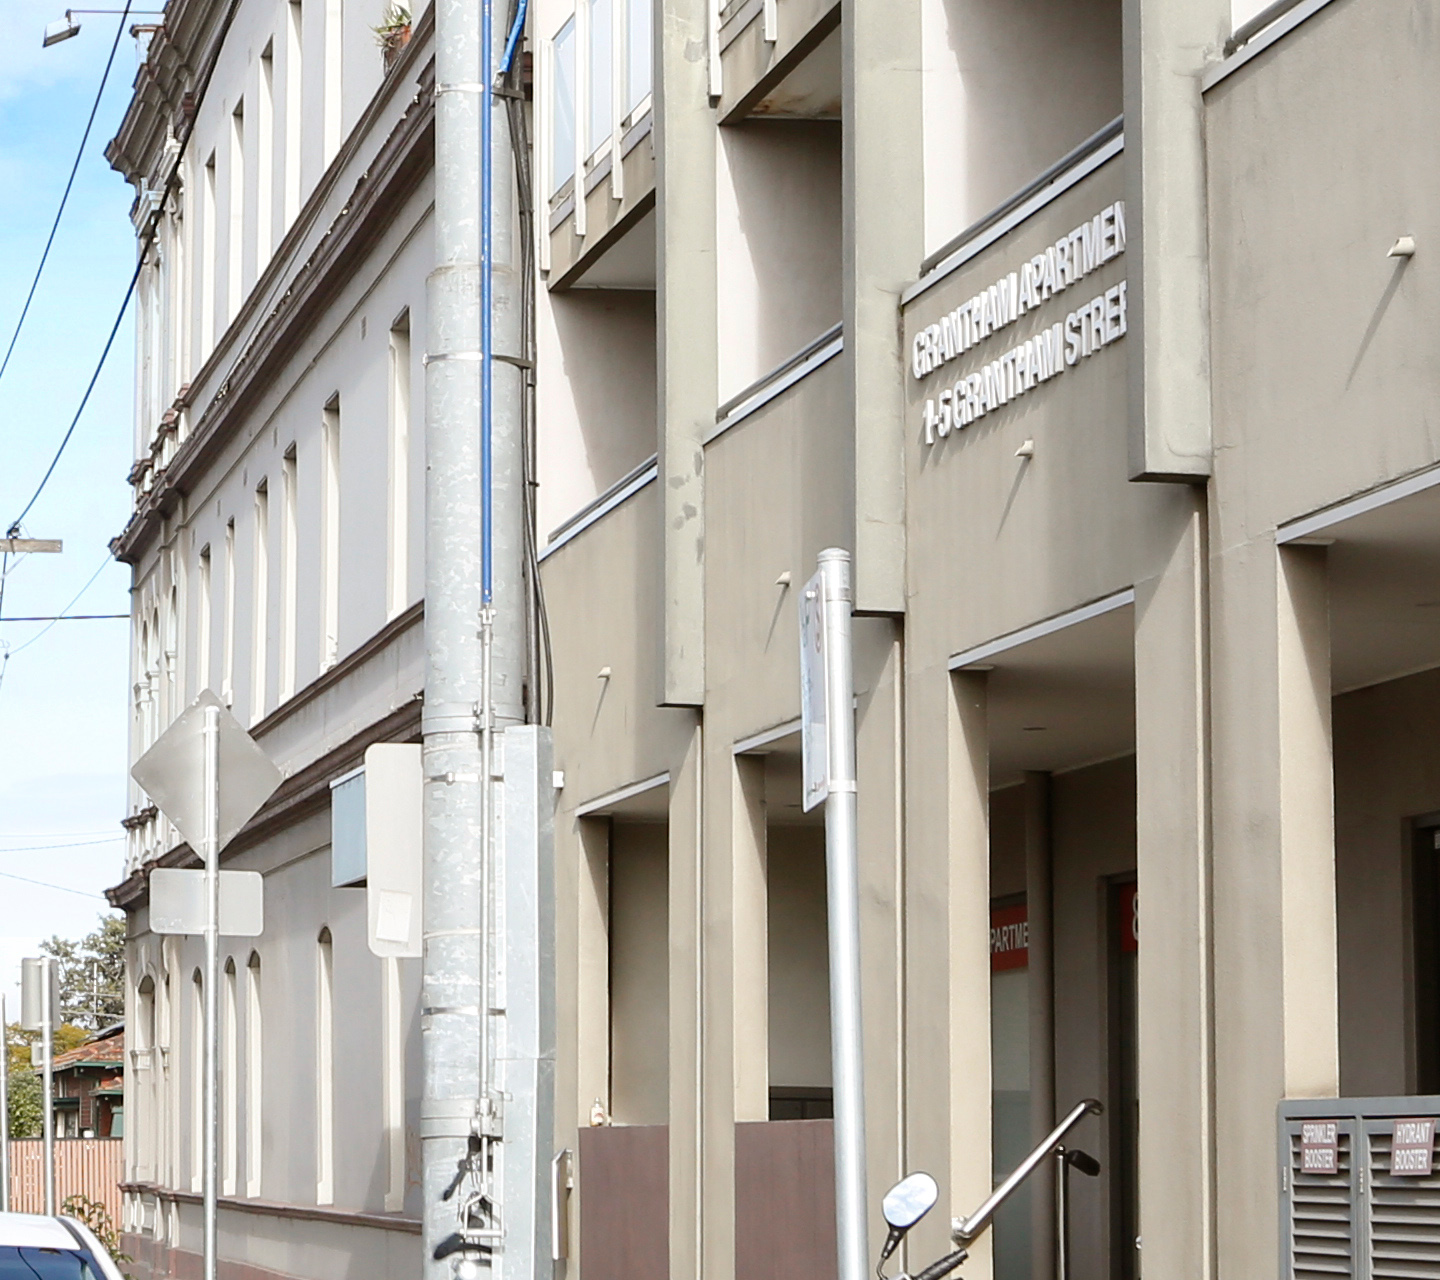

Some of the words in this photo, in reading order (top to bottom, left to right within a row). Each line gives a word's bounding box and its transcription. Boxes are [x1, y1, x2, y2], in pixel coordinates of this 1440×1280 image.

[912, 272, 1018, 380] GRANTHAM
[923, 388, 952, 444] 1-5
[952, 322, 1064, 430] GRANTHAM
[1302, 1123, 1337, 1144] SPRINKLER
[1396, 1122, 1431, 1144] HYDRANT
[1304, 1148, 1334, 1169] BOOSTER
[1394, 1148, 1428, 1170] BOOSTER
